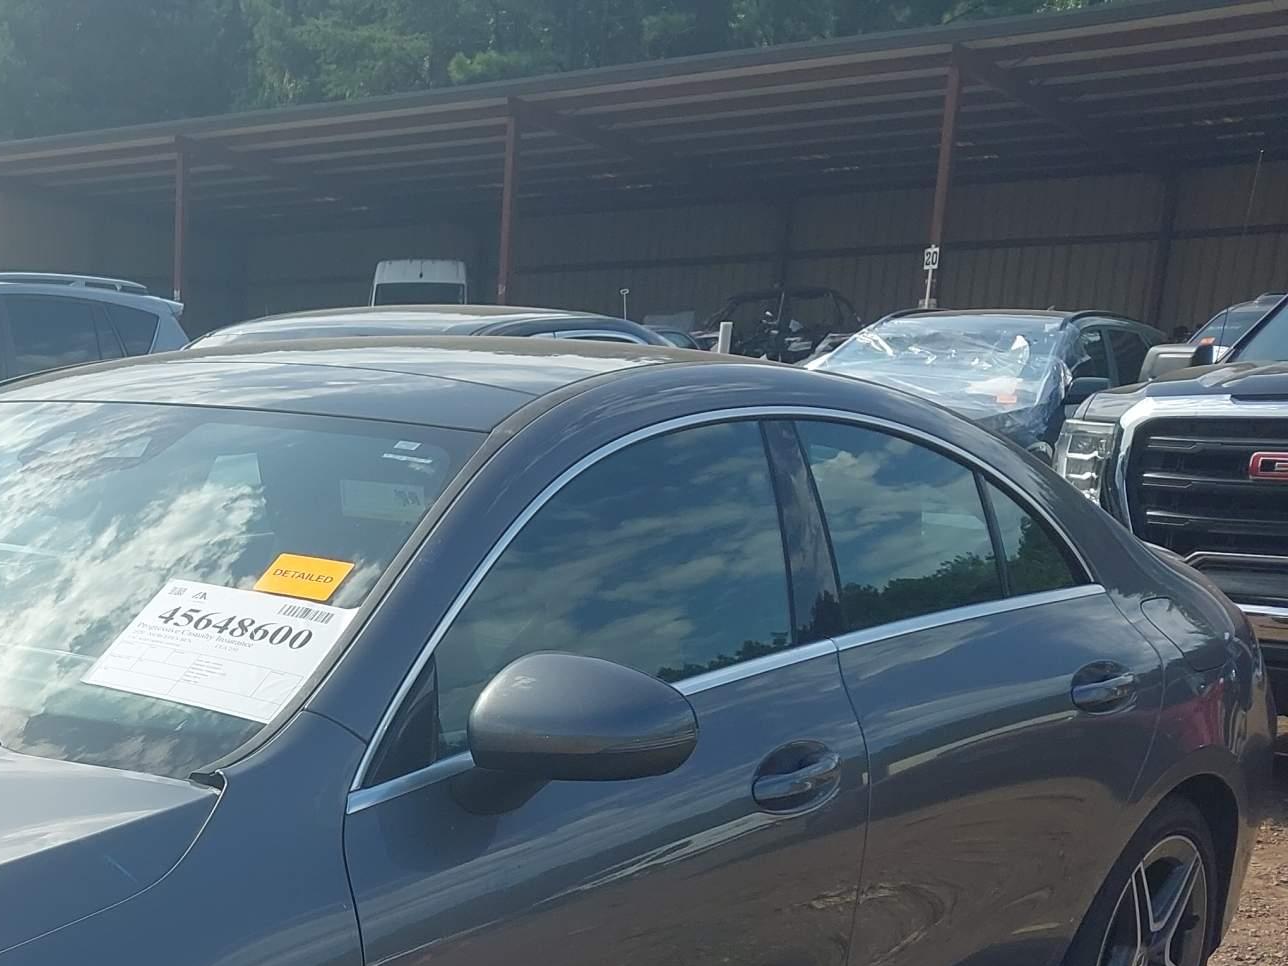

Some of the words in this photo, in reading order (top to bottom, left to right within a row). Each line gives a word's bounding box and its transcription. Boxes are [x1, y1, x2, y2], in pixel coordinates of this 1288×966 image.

[925, 251, 938, 266] 20
[272, 568, 334, 584] DETAILED
[158, 606, 313, 650] 45648600
